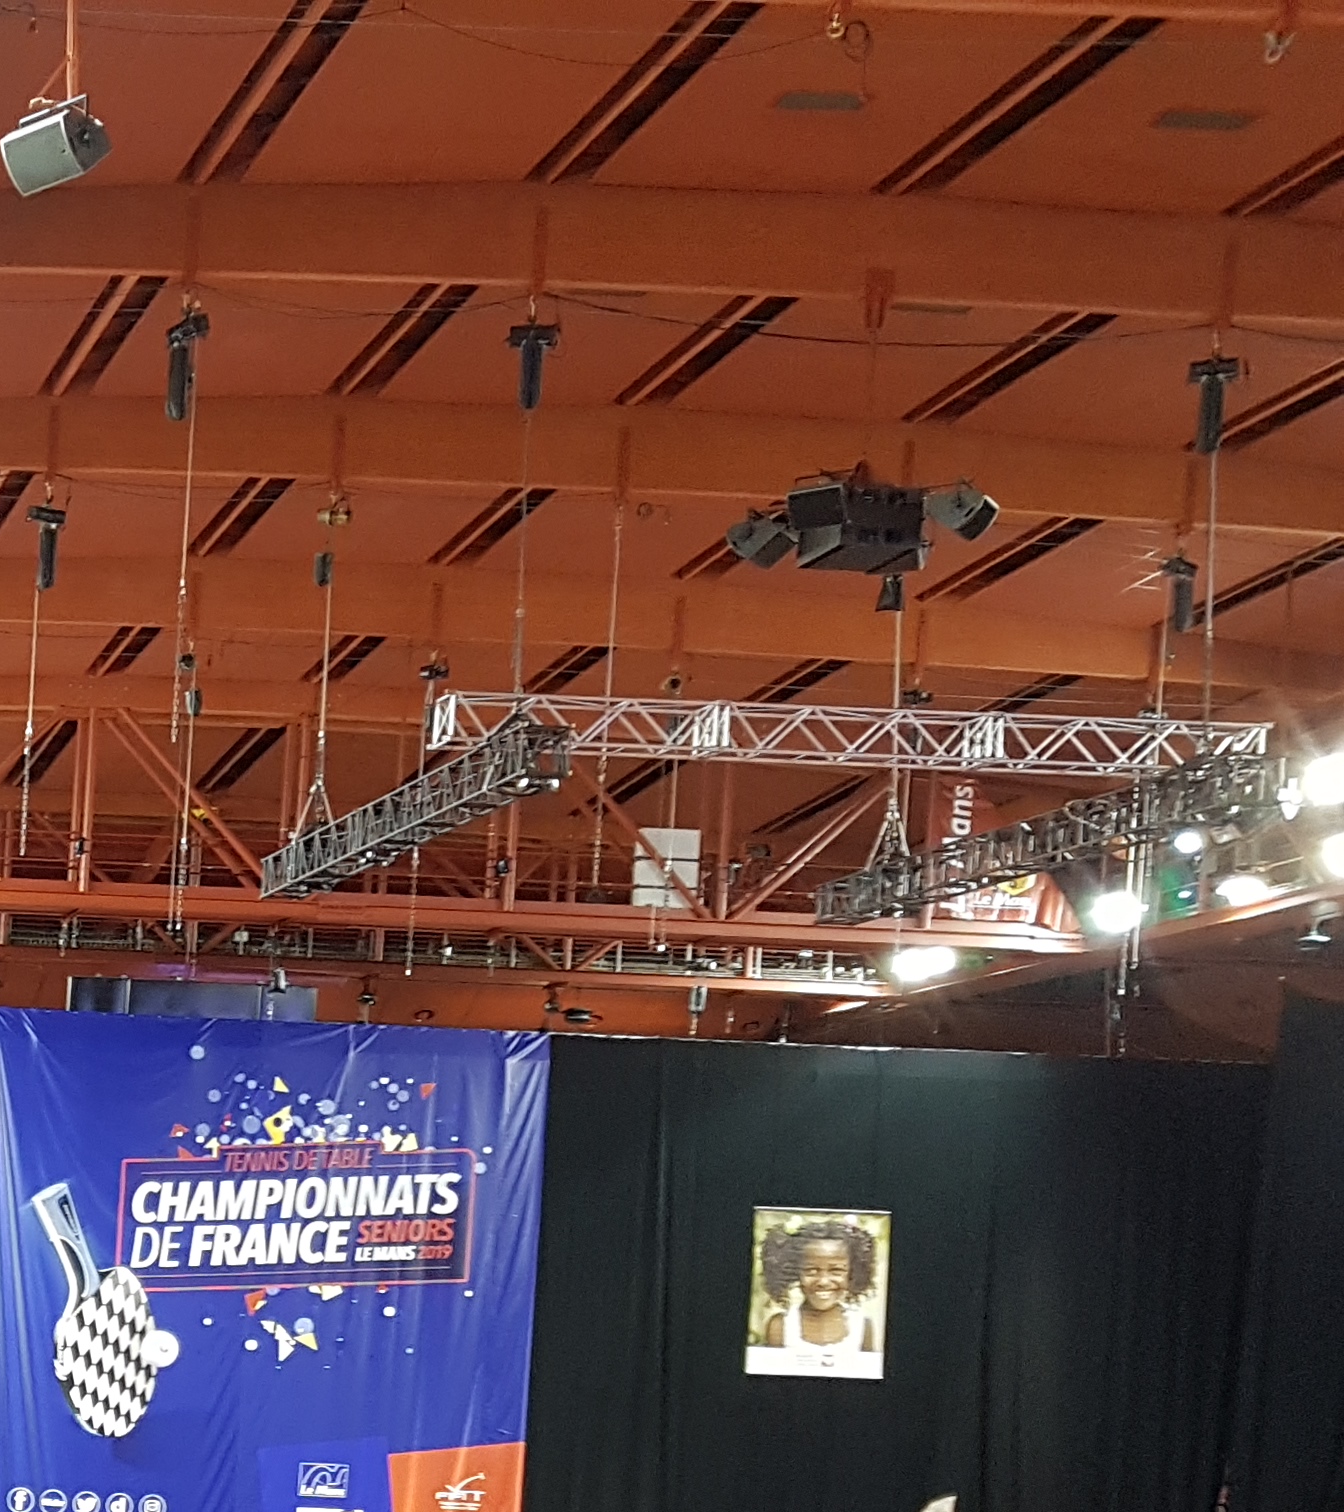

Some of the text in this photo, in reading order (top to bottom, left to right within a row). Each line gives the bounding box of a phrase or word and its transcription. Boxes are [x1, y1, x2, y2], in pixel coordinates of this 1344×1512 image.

[224, 1150, 290, 1172] TENNIS
[315, 1147, 374, 1169] TABLE
[131, 1173, 462, 1223] CHAMPIONNATS
[355, 1218, 456, 1243] SENIORS
[130, 1221, 351, 1269] DE FRANCE
[417, 1245, 453, 1260] 2019
